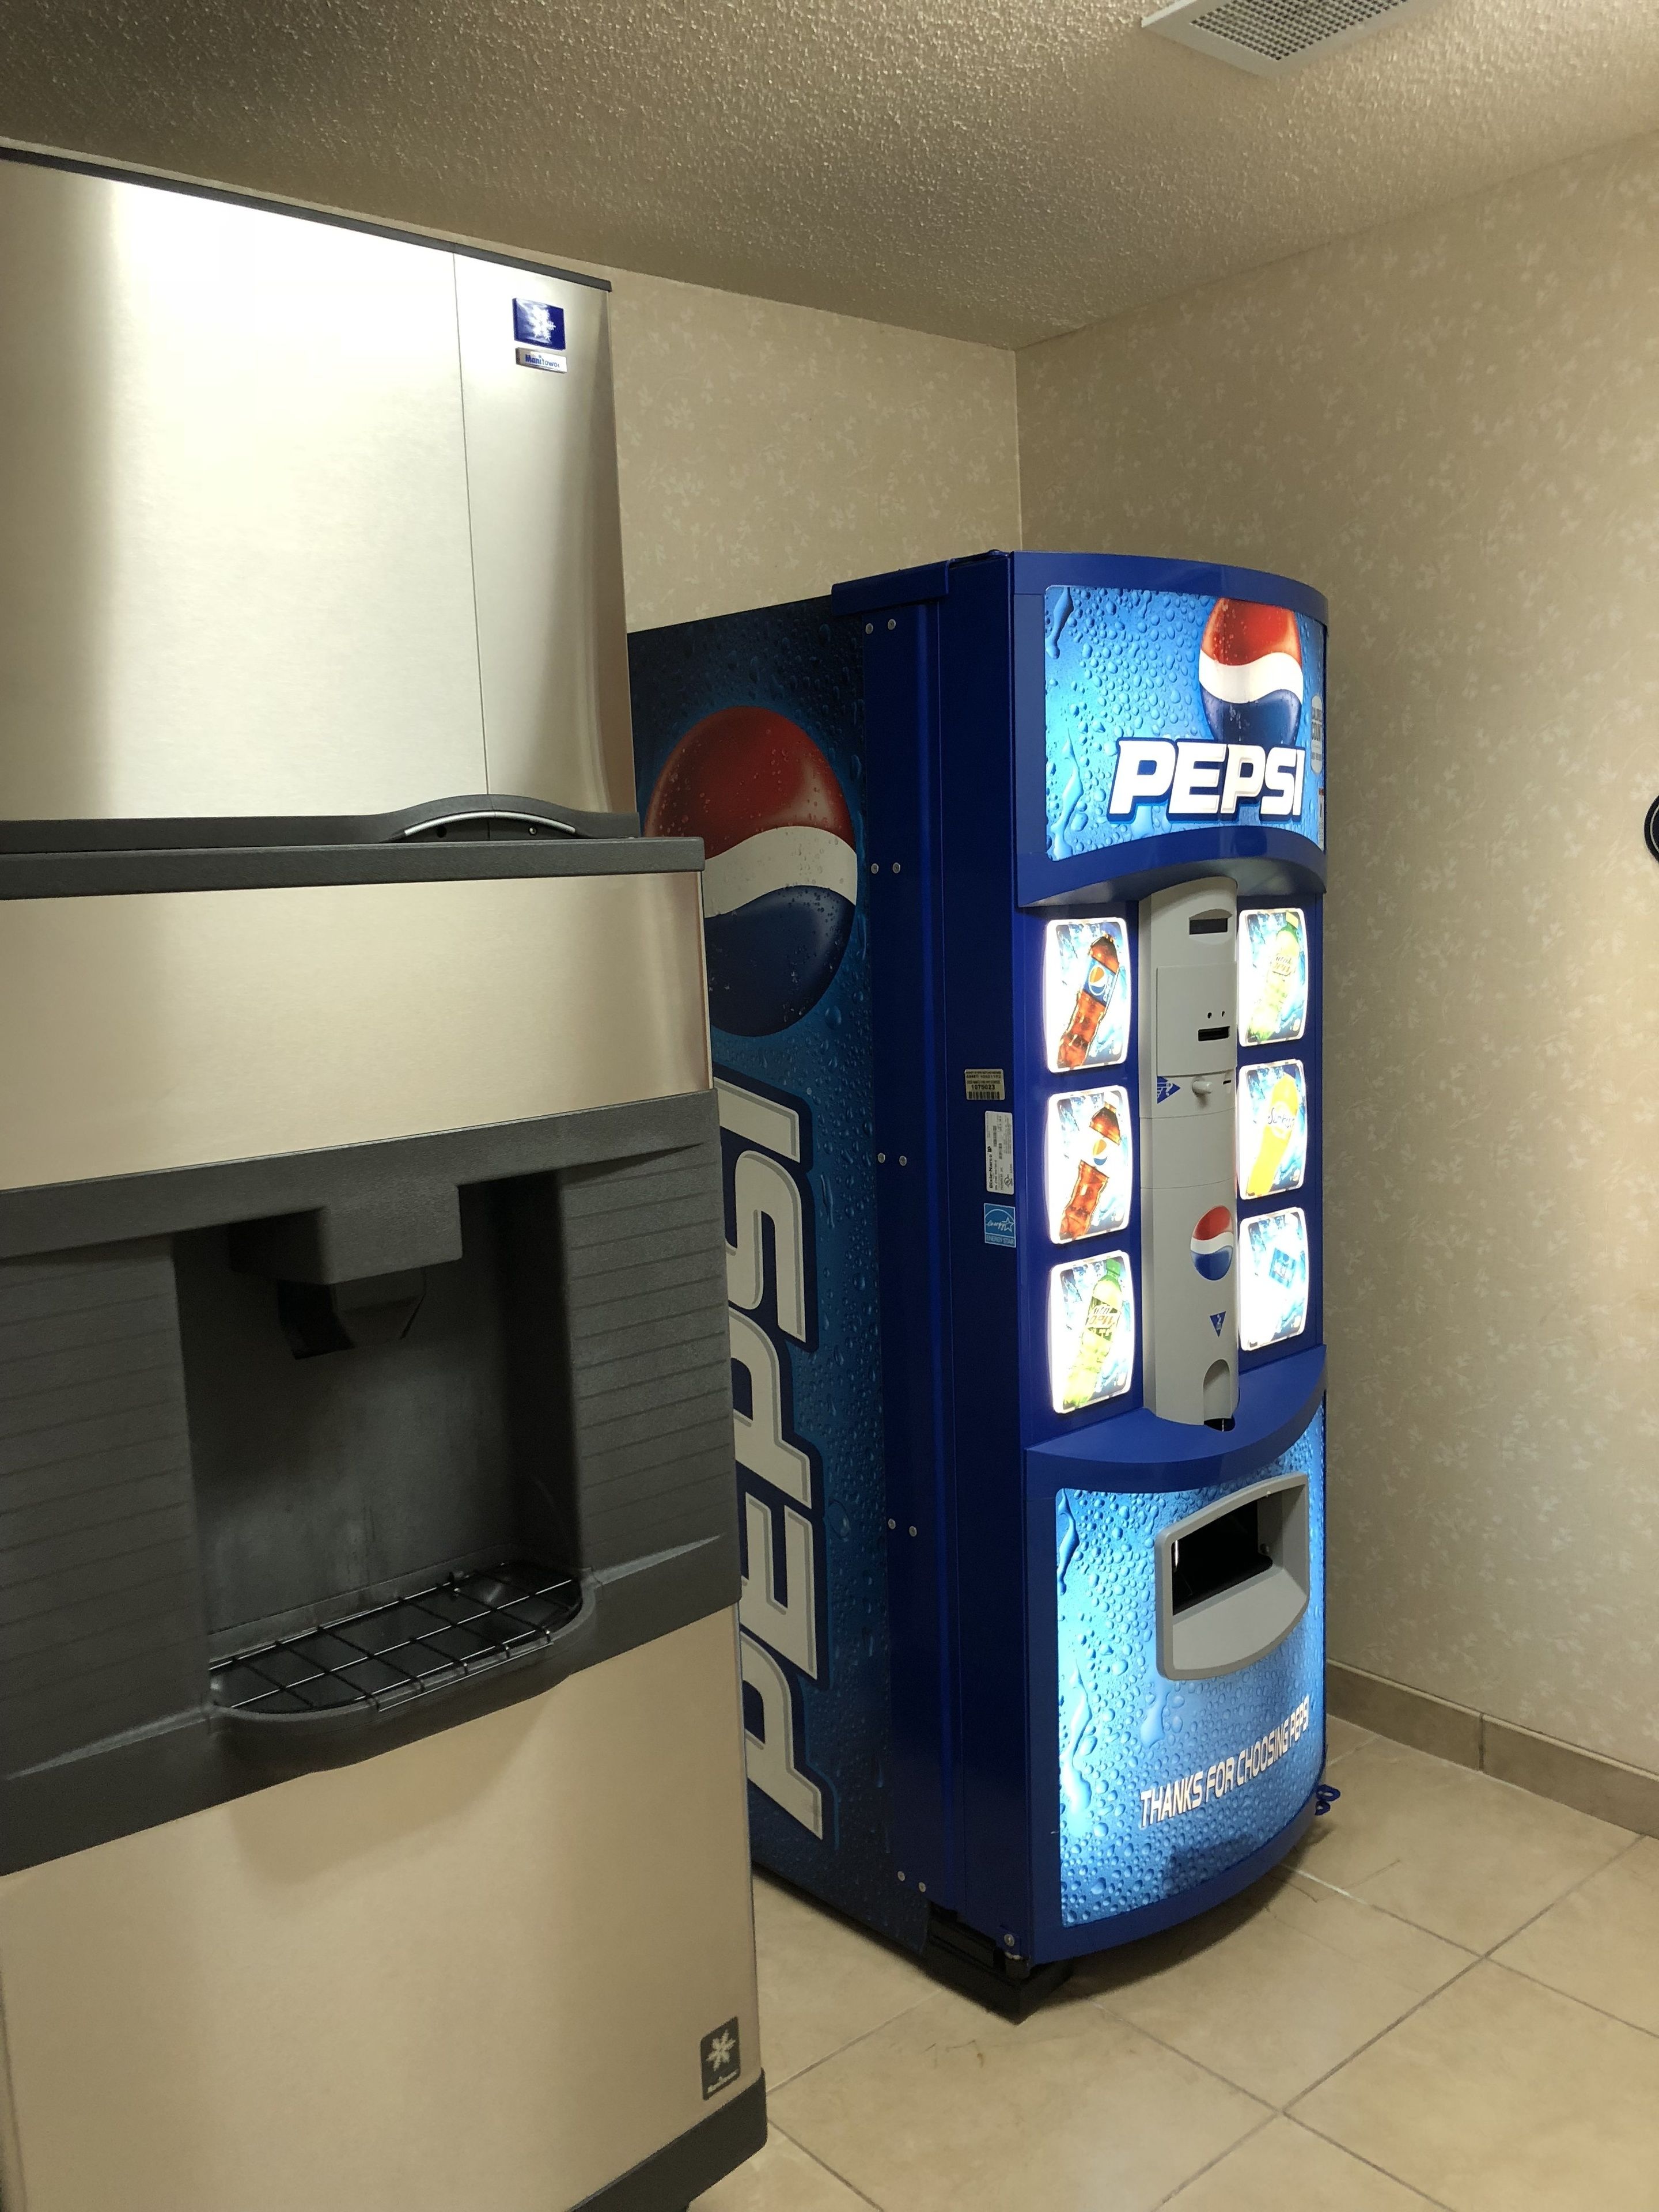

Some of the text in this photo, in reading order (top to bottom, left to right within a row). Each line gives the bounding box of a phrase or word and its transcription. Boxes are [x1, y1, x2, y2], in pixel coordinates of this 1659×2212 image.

[1108, 738, 1306, 818] PEPSI
[1140, 1770, 1203, 1828] THANKS
[1205, 1756, 1235, 1803] FOR
[1236, 1718, 1289, 1786] CHOOSING
